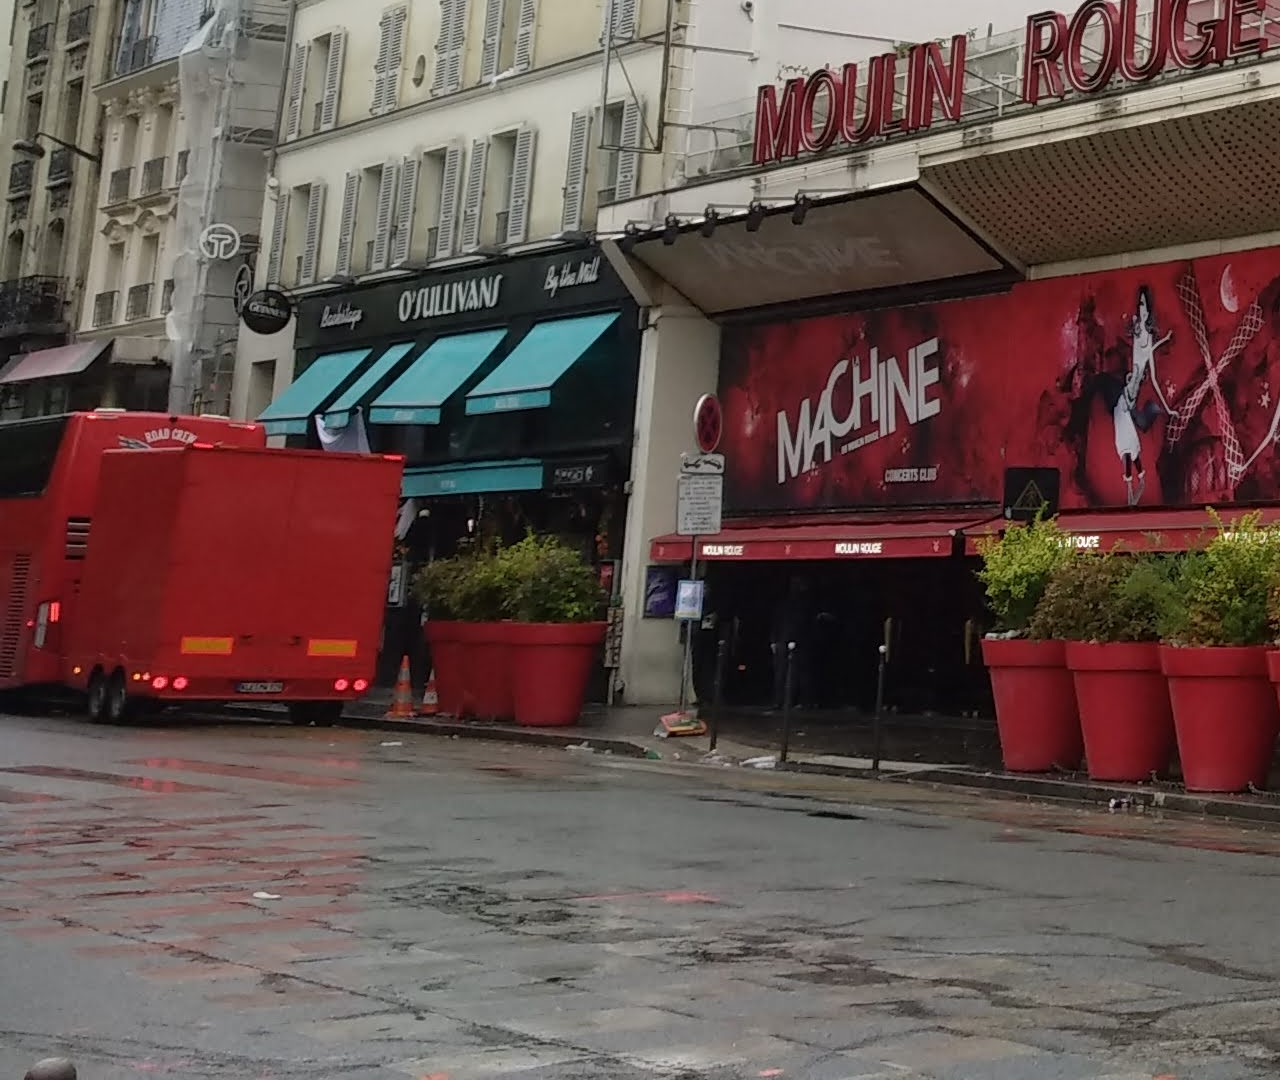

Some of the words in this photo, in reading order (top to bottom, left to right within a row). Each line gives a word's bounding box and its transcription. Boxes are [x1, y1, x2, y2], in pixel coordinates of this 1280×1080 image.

[753, 35, 967, 166] MOULIN
[558, 261, 576, 288] the
[575, 256, 600, 285] Mill
[399, 274, 503, 322] O'SULLIVANS
[777, 337, 941, 484] MACHINE
[144, 428, 170, 443] ROAD
[835, 543, 859, 555] MOULIN
[860, 542, 882, 554] ROUGE
